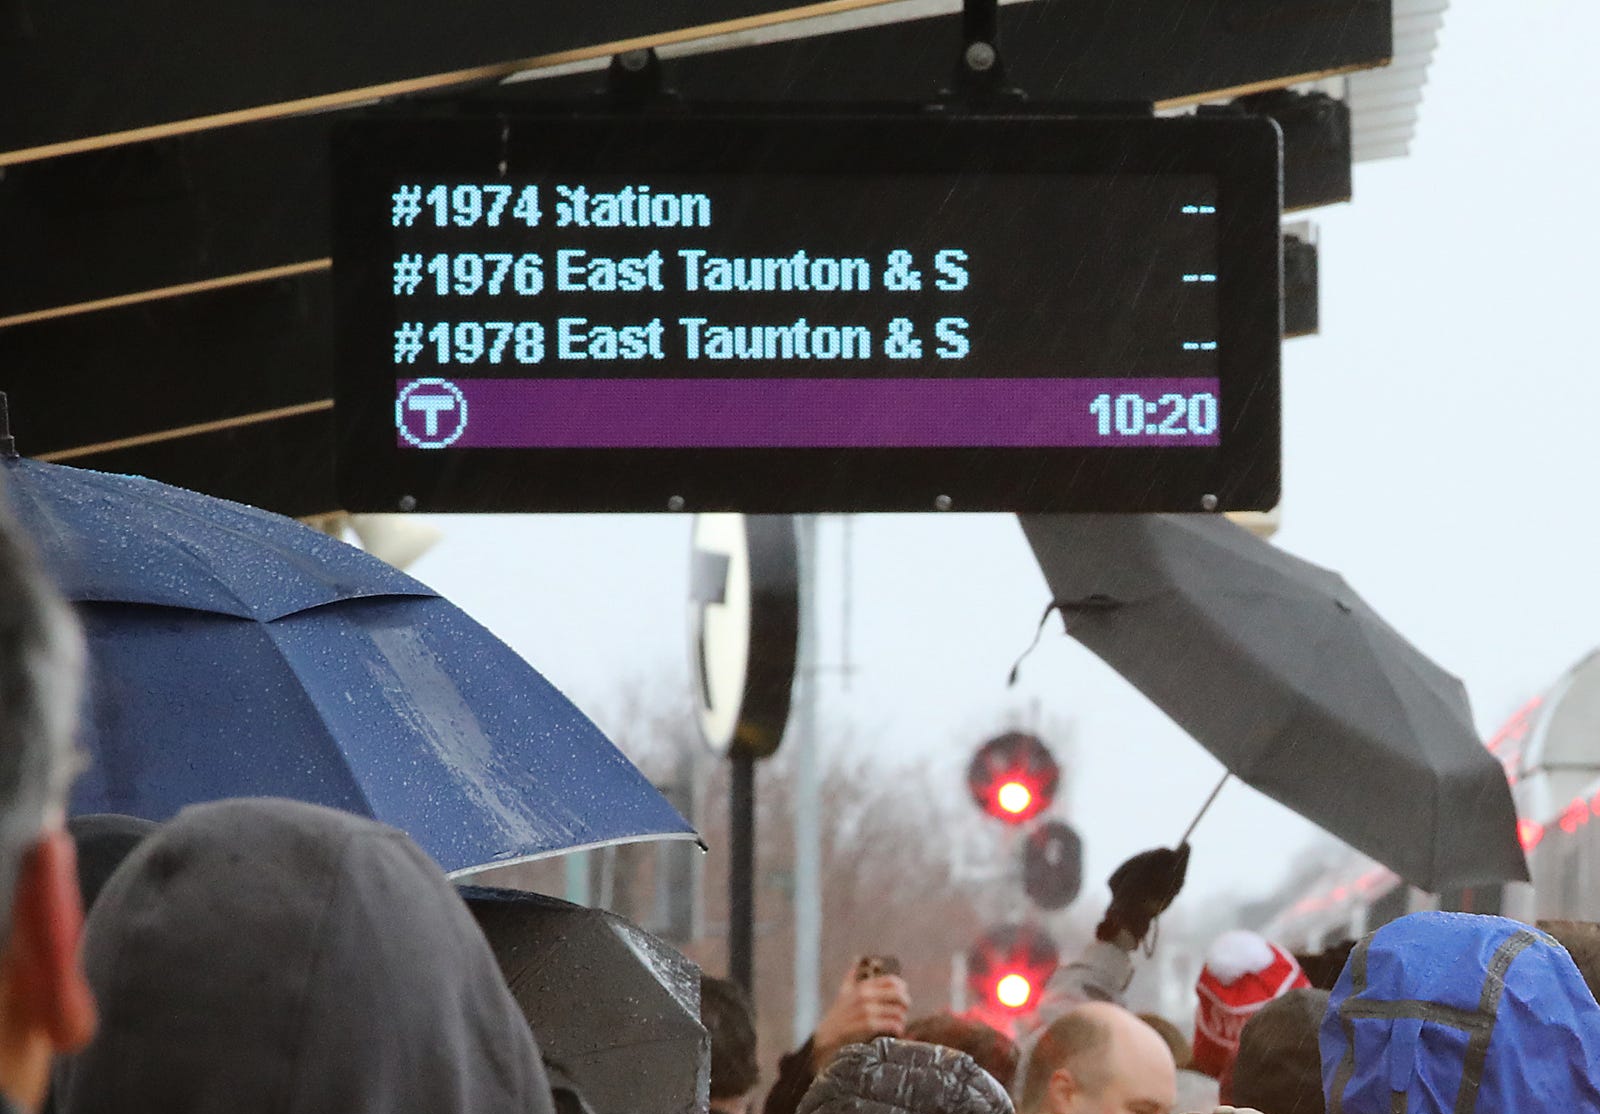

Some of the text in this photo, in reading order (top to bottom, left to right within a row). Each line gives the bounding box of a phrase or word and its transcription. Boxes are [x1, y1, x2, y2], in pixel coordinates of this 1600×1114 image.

[391, 184, 543, 228] #1974
[393, 253, 544, 296] #1976
[556, 249, 665, 292] East
[677, 249, 871, 292] Taunton
[883, 249, 922, 292] &
[934, 249, 969, 292] S
[393, 321, 545, 364] #1978
[557, 317, 665, 360] East
[678, 317, 871, 360] Taunton
[883, 317, 923, 360] &
[935, 317, 970, 360] S
[1088, 392, 1218, 437] 10:20
